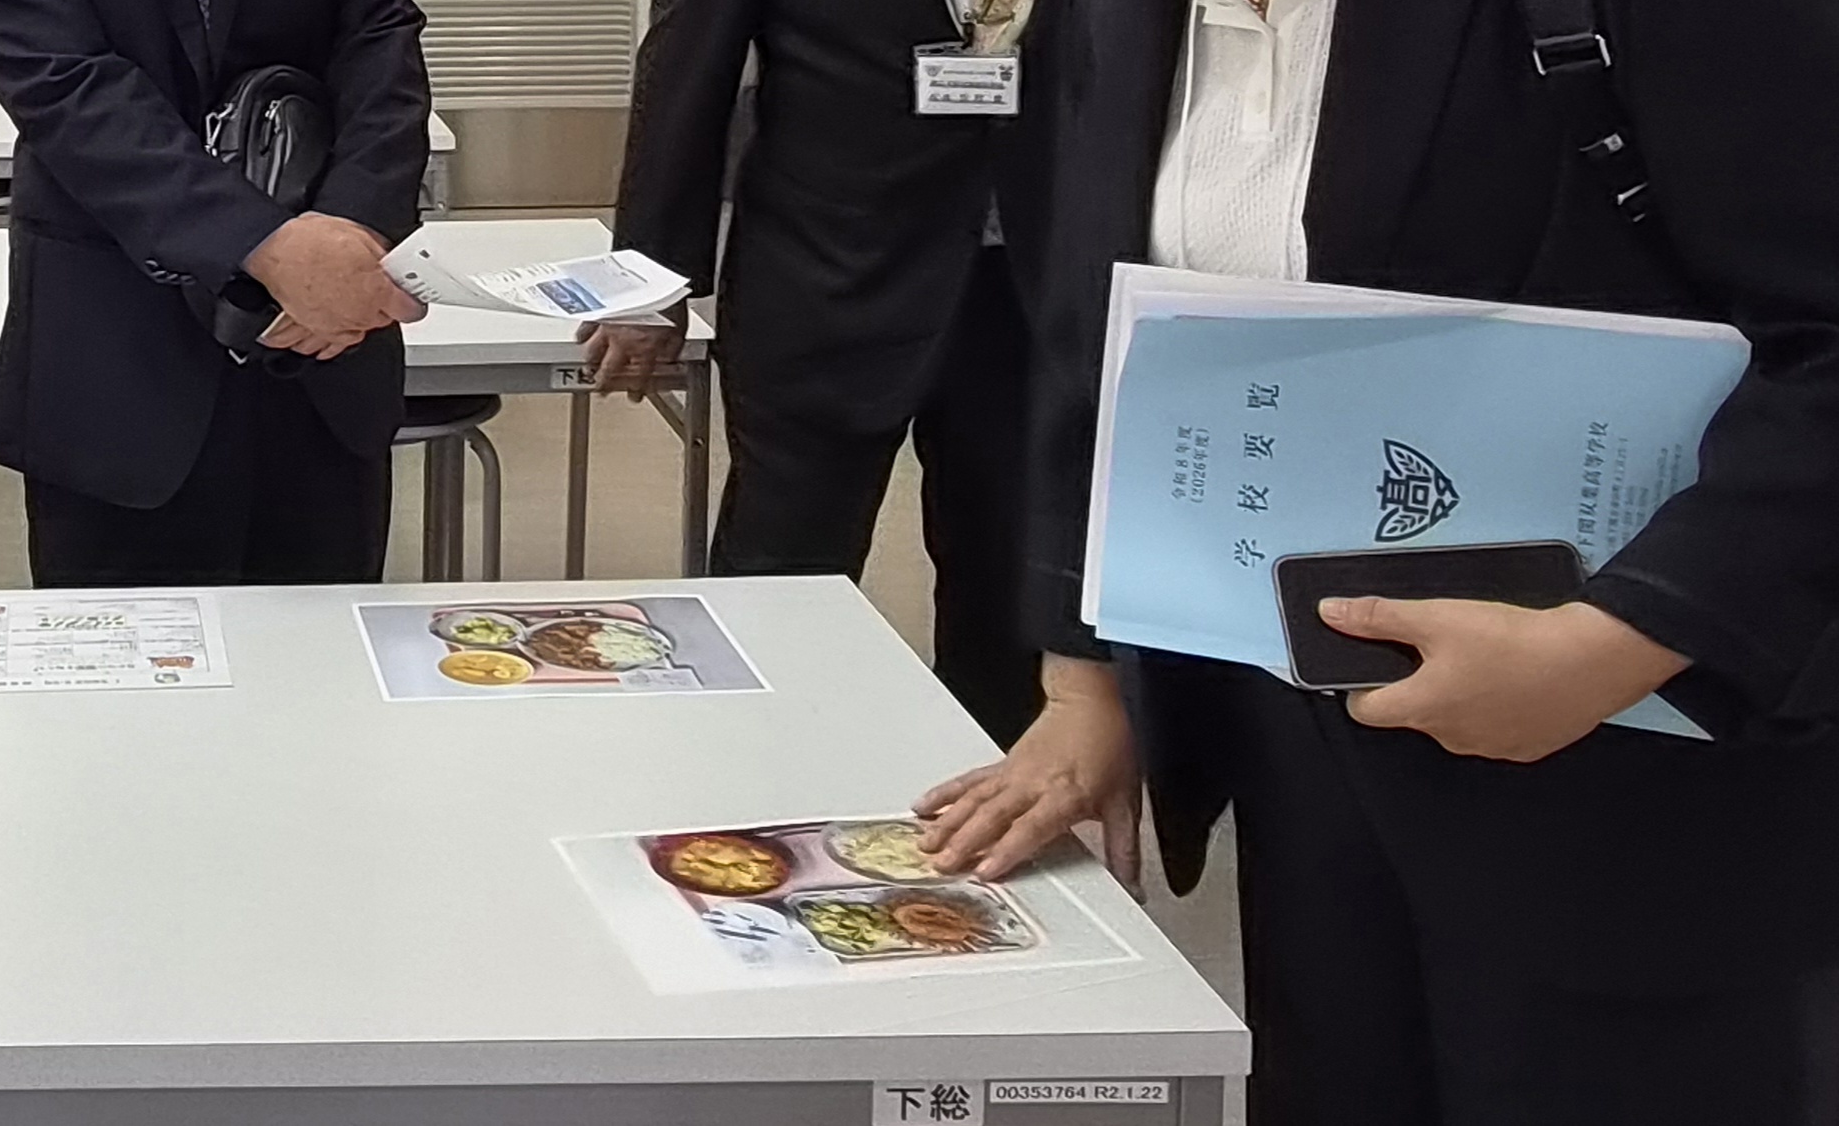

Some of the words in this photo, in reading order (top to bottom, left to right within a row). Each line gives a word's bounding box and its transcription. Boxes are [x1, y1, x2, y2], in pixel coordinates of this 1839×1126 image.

[1234, 382, 1280, 568] 学校要覧
[886, 1084, 971, 1122] 下総
[995, 1086, 1086, 1100] 00353764
